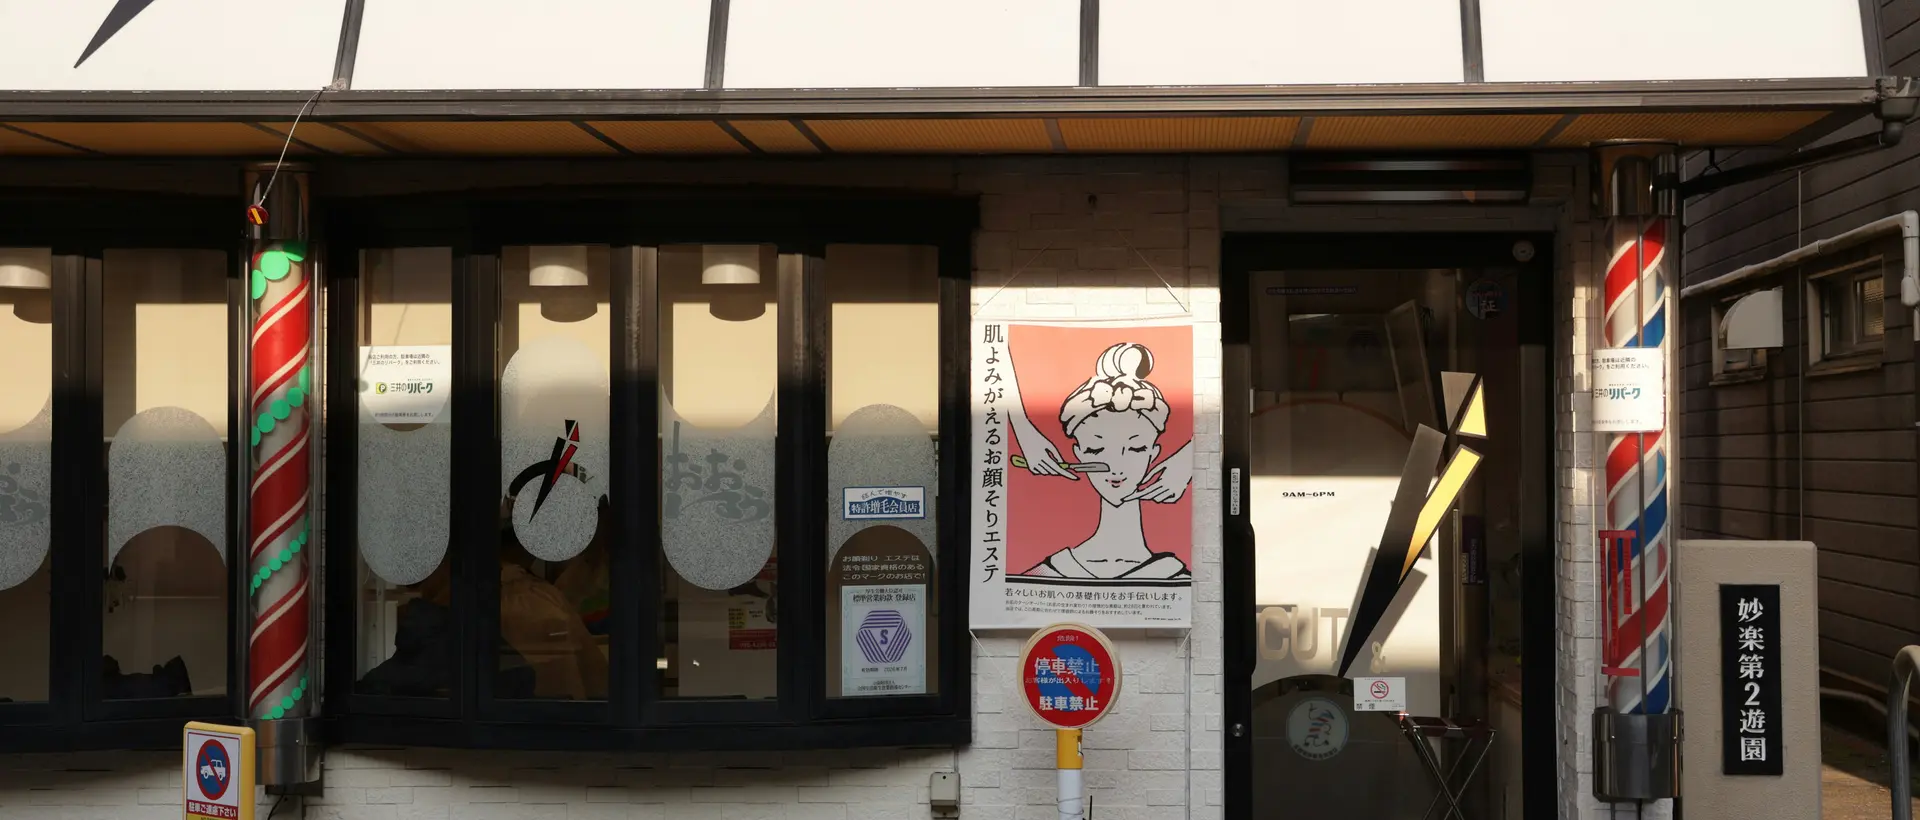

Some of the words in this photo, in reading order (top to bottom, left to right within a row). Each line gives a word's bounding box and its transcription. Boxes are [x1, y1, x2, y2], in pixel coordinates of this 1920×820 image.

[390, 382, 433, 394] 三井のリパーク
[1595, 386, 1641, 400] 三井のリパーク
[982, 323, 1004, 583] 肌よみがえるお顔そりエステ
[851, 498, 918, 514] 特許増毛会員店
[1005, 588, 1183, 602] 若々しいお肌への基礎作りをお手伝いします。
[880, 629, 889, 645] S
[1258, 606, 1348, 662] CUT
[1034, 657, 1101, 676] 停車禁止
[1737, 596, 1767, 762] 妙楽第2遊園
[1039, 695, 1100, 712] 駐車禁止
